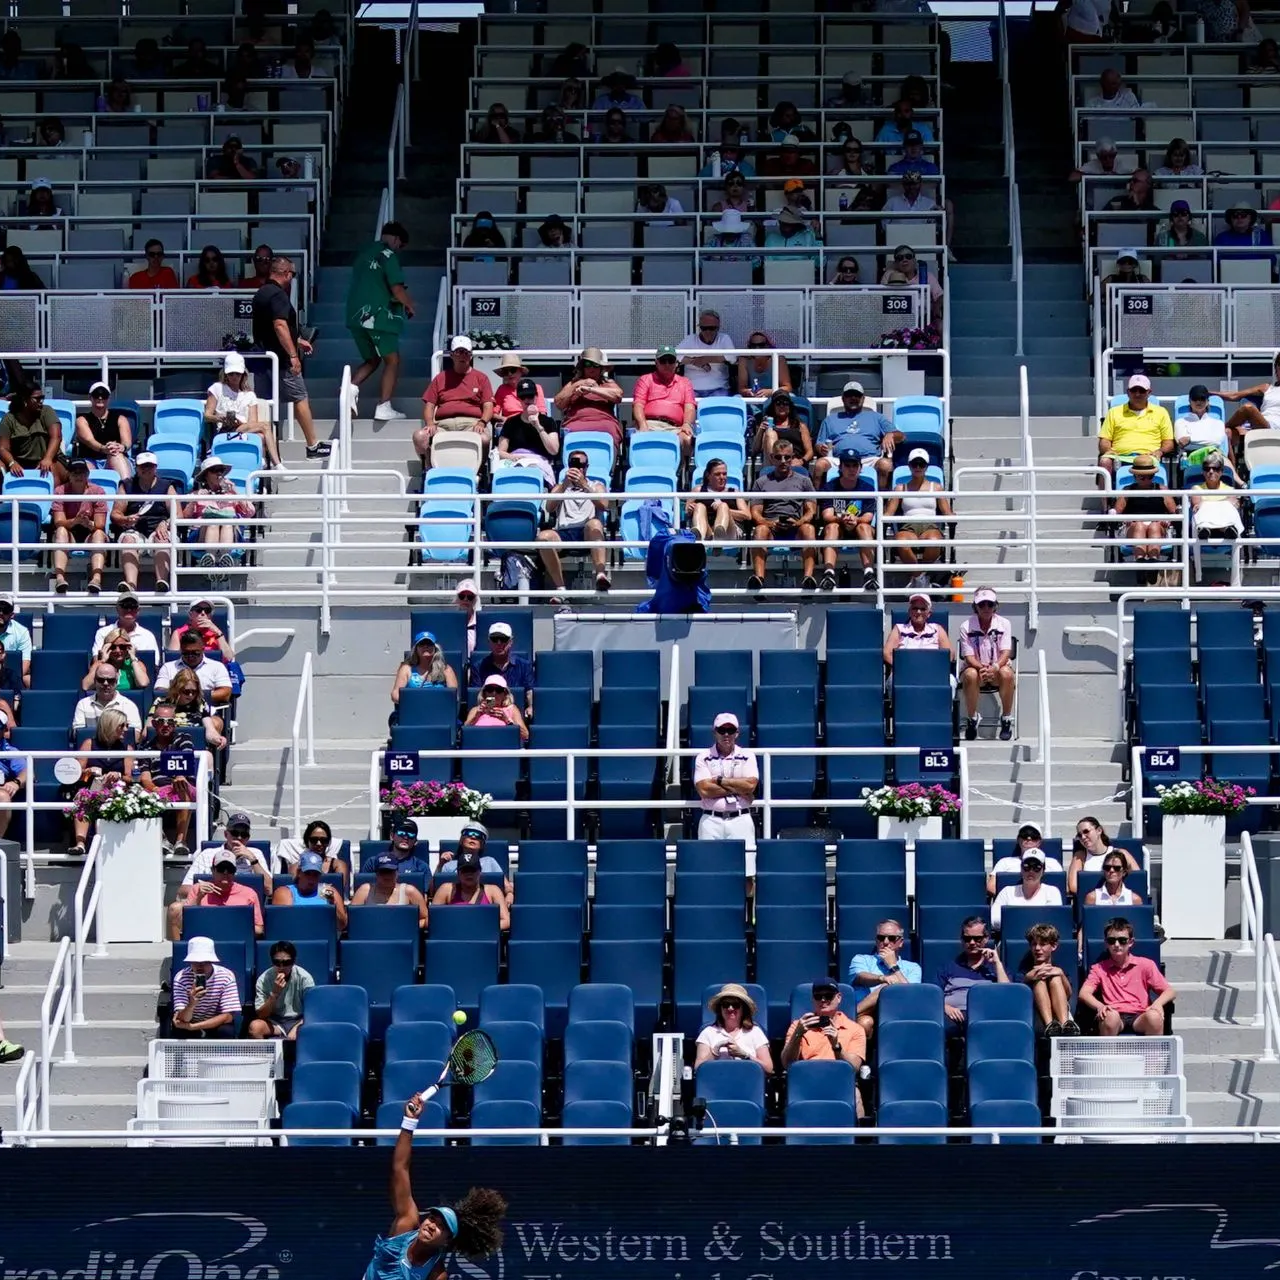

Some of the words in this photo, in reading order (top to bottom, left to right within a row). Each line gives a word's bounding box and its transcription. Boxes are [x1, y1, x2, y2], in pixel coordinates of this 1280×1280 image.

[239, 304, 253, 313] 30
[475, 302, 496, 311] 307
[887, 300, 907, 309] 308
[1127, 300, 1148, 309] 308
[167, 760, 187, 771] BL1
[390, 759, 414, 770] BL2
[925, 756, 949, 767] BL3
[1150, 755, 1174, 766] BL4
[512, 1222, 691, 1262] Western
[703, 1221, 744, 1262] &
[759, 1221, 955, 1262] Southern
